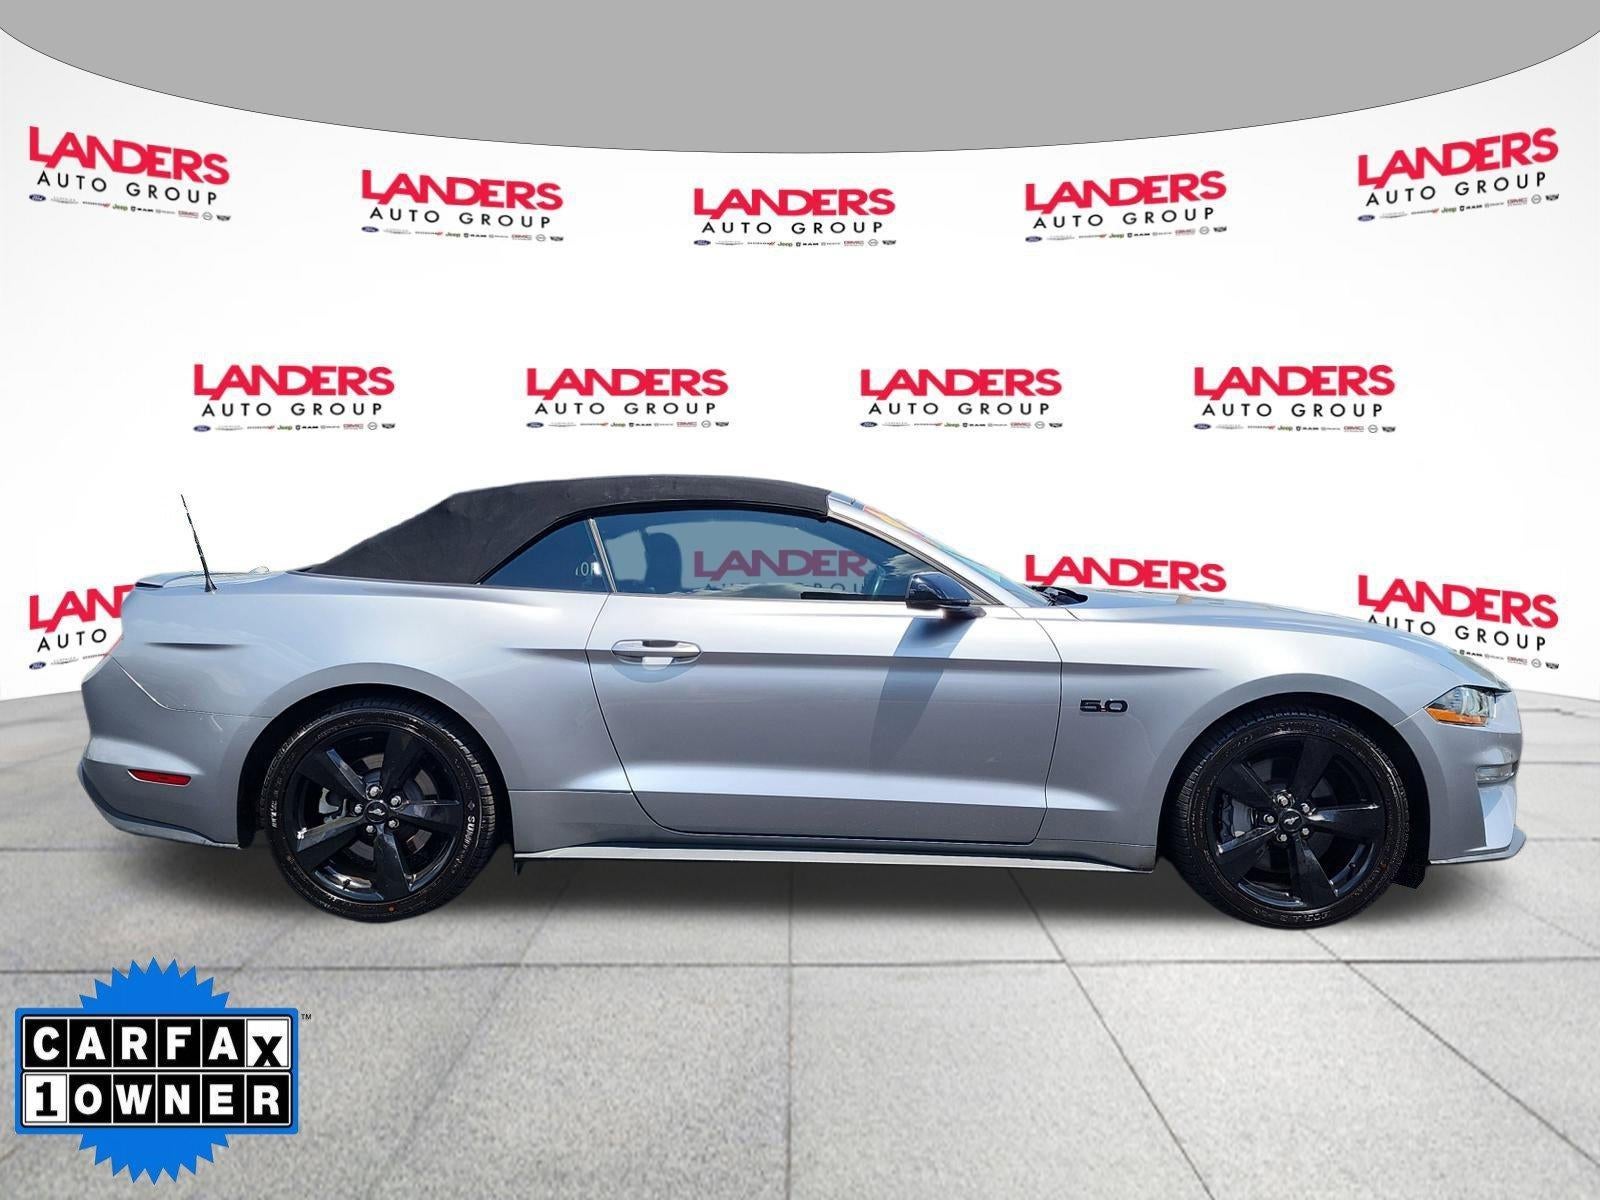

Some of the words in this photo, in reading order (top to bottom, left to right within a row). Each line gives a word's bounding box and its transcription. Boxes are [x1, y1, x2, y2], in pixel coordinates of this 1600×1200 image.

[29, 126, 230, 185] LANDERS
[1358, 128, 1558, 189] LANDERS
[37, 171, 106, 192] AUTO
[127, 182, 217, 205] GROUP
[362, 170, 563, 211] LANDERS
[694, 188, 895, 220] LANDERS
[1025, 171, 1226, 214] LANDERS
[1366, 186, 1435, 206] AUTO
[1455, 172, 1545, 195] GROUP
[370, 207, 439, 223] AUTO
[459, 213, 550, 228] GROUP
[702, 222, 771, 234] AUTO
[792, 222, 882, 234] GROUP
[1033, 214, 1103, 229] AUTO
[1123, 207, 1213, 224] GROUP
[194, 364, 394, 400] LANDERS
[527, 368, 729, 400] LANDERS
[860, 369, 1062, 400] LANDERS
[1194, 365, 1395, 400] LANDERS
[202, 403, 271, 416] AUTO
[291, 403, 382, 416] GROUP
[535, 403, 604, 414] AUTO
[624, 403, 715, 414] GROUP
[869, 403, 938, 415] AUTO
[958, 403, 1049, 415] GROUP
[1203, 404, 1272, 416] AUTO
[1292, 403, 1382, 417] GROUP
[1025, 555, 1226, 592] LANDERS
[1358, 575, 1558, 629] LANDERS
[37, 629, 106, 652] AUTO
[1455, 626, 1545, 651] GROUP
[1080, 699, 1128, 712] 5.0
